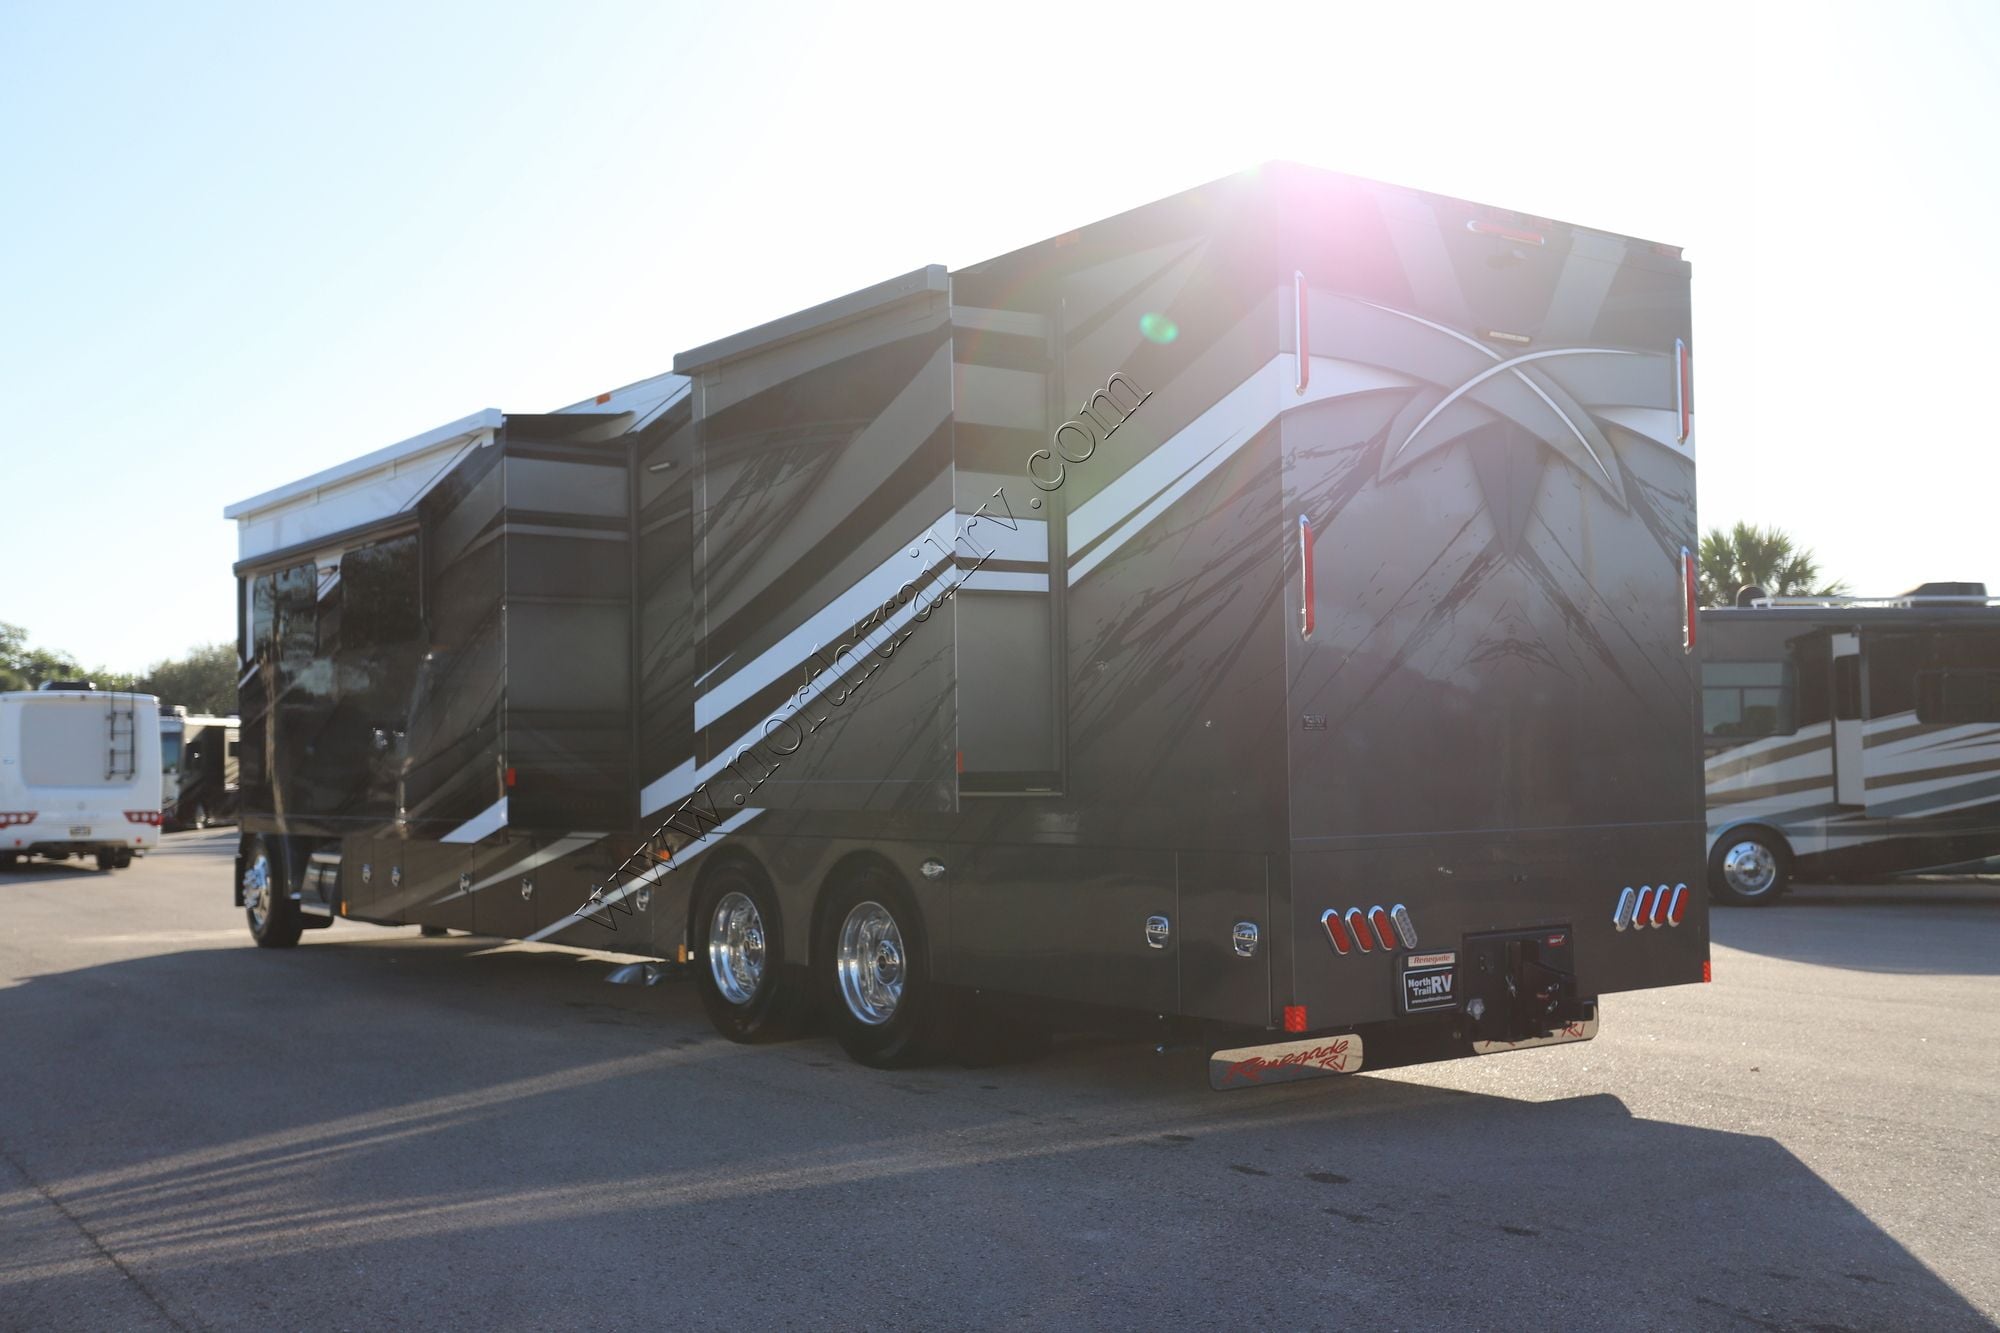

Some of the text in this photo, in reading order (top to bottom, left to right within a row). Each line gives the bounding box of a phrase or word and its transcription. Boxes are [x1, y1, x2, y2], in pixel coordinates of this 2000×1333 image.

[1408, 977, 1431, 988] North
[1431, 974, 1453, 994] RV
[1413, 986, 1431, 996] Trail
[1221, 1039, 1349, 1083] Renegade
[1319, 1055, 1347, 1071] RV
